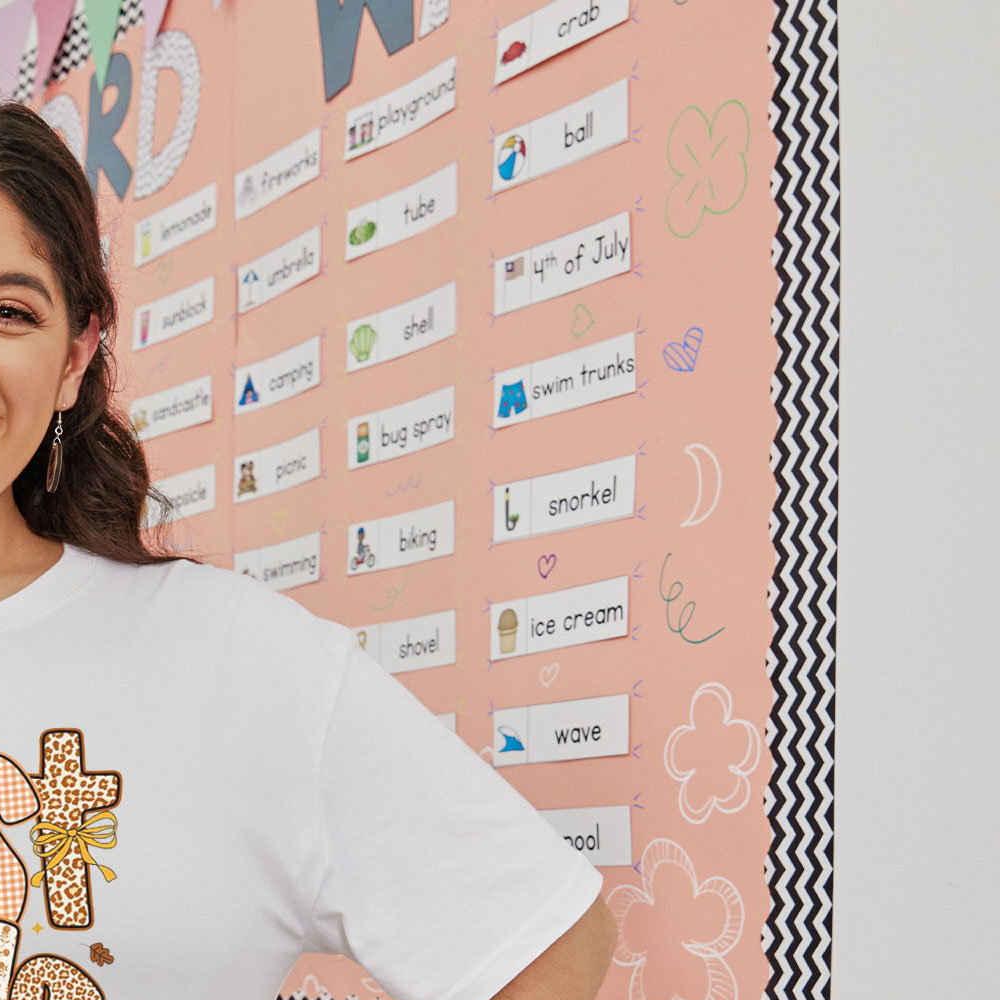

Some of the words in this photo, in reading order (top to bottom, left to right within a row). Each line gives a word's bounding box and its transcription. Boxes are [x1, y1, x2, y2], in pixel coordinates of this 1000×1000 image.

[557, 0, 600, 37] crab
[378, 66, 456, 136] playground
[564, 110, 594, 149] ball
[261, 147, 319, 191] fireworks
[160, 200, 213, 241] lemonade
[403, 194, 436, 225] tube
[267, 246, 315, 288] umbrella
[534, 251, 558, 284] 4th
[564, 244, 586, 275] of
[592, 230, 629, 265] July
[161, 292, 207, 329] sunblock
[403, 305, 434, 341] shell
[269, 360, 314, 392] camping
[532, 374, 574, 400] swim
[580, 352, 635, 384] trunks
[153, 388, 210, 422] sandcastle
[381, 424, 408, 448] bug
[413, 411, 452, 442] spray
[275, 455, 307, 485] picnic
[548, 475, 617, 516] snorkel
[399, 526, 437, 552] biking
[262, 555, 317, 582] swimming
[531, 617, 556, 638] ice
[563, 604, 624, 632] cream
[399, 628, 440, 659] shovel
[554, 725, 602, 745] wave
